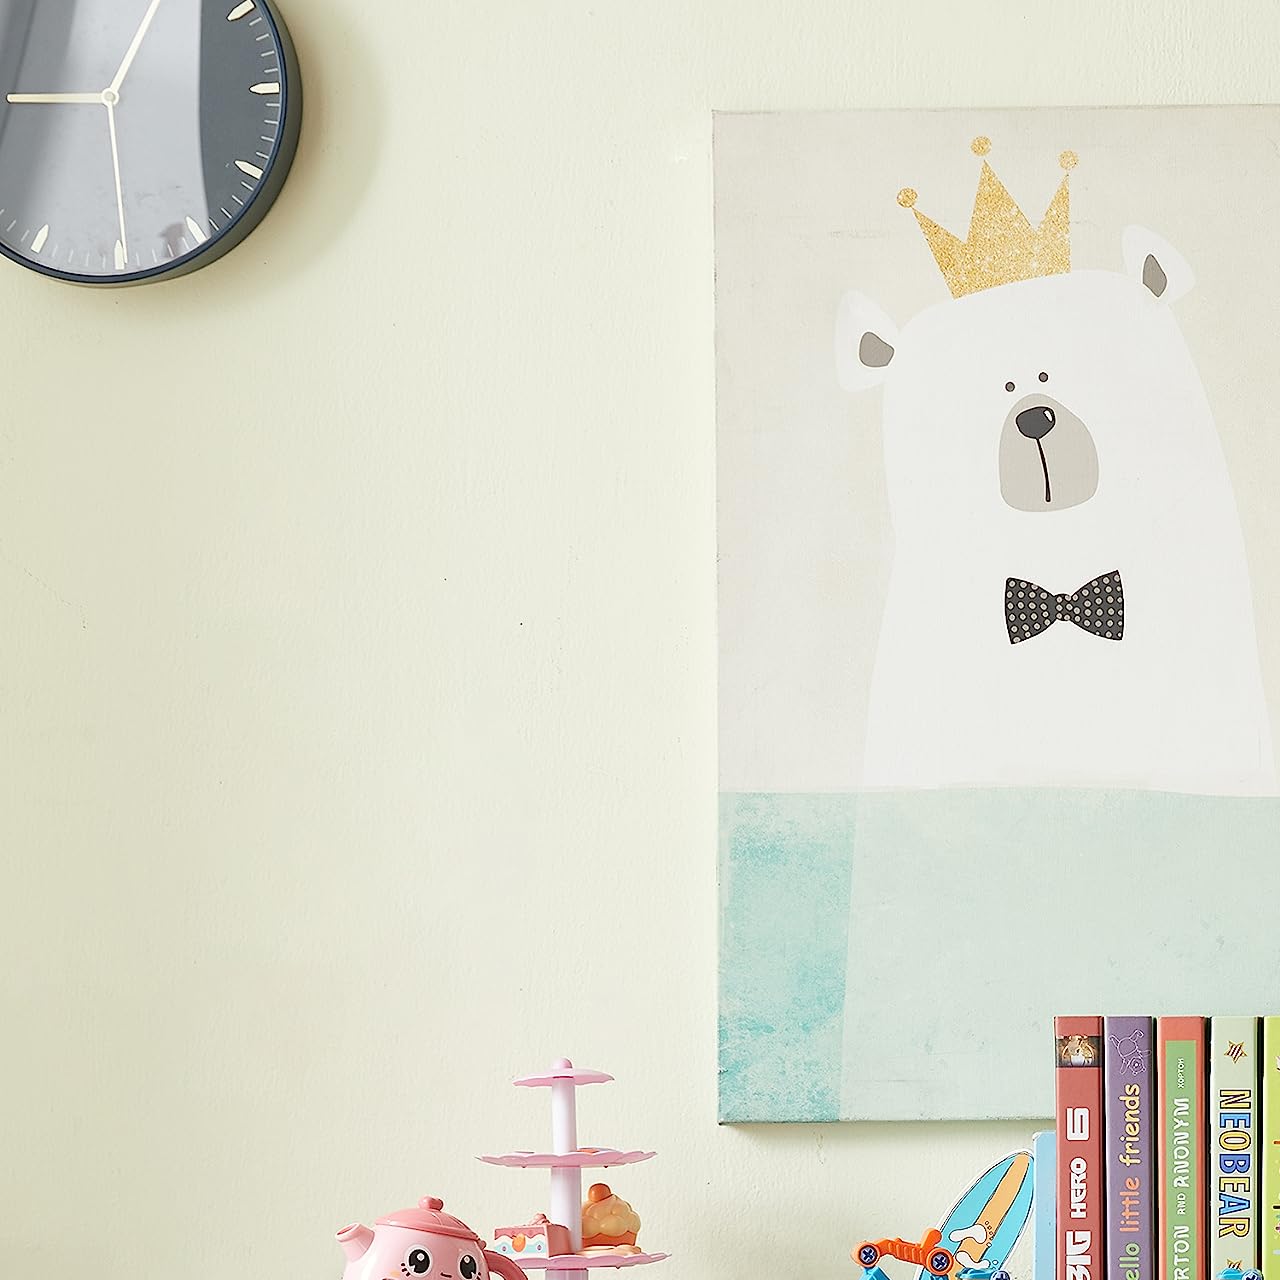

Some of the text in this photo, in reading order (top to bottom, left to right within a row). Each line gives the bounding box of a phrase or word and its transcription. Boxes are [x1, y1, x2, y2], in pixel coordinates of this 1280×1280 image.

[1066, 1107, 1090, 1141] 6
[1119, 1083, 1141, 1167] friends
[1173, 1097, 1190, 1189] ANONYM
[1070, 1157, 1087, 1218] HERO
[1218, 1088, 1252, 1239] NEOBEAR
[1119, 1176, 1140, 1232] little
